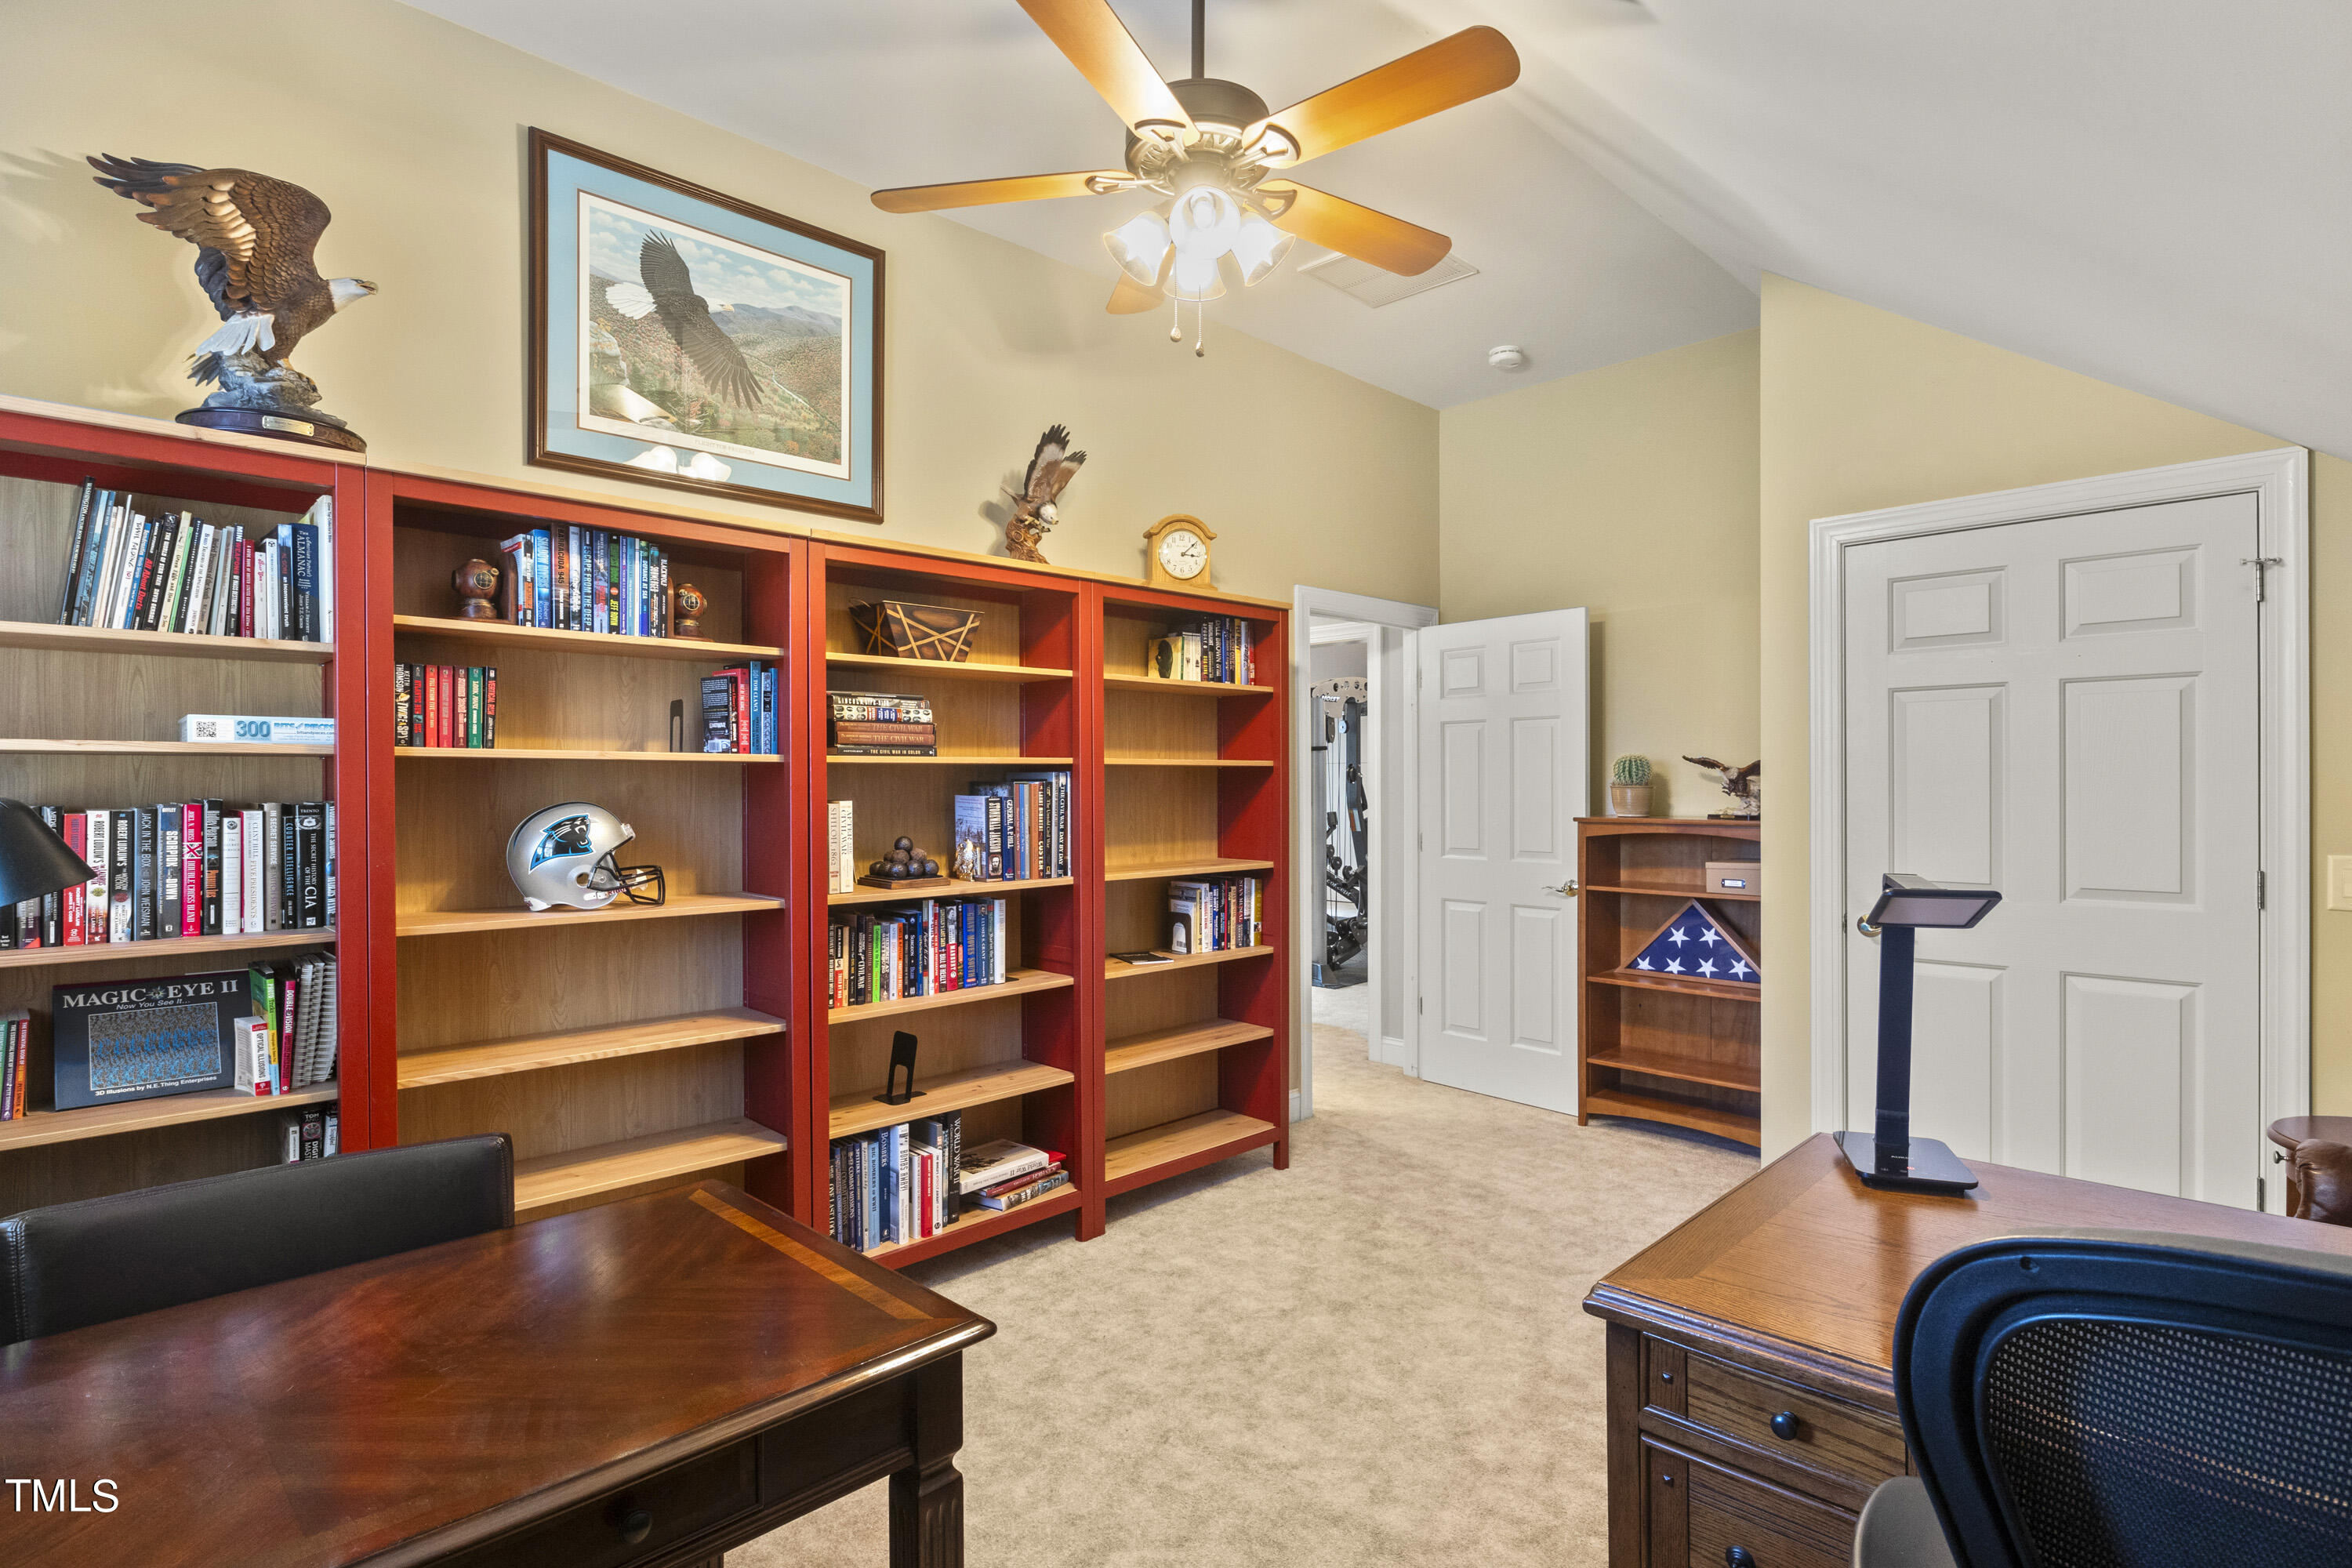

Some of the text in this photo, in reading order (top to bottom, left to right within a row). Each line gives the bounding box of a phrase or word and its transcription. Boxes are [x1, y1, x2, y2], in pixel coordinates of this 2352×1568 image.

[235, 525, 244, 543] MINI
[162, 541, 170, 556] WORLD
[232, 542, 241, 575] WEAPONS
[297, 535, 307, 577] ALMANAC
[583, 546, 592, 573] ESCAPE
[158, 563, 166, 574] STAR
[537, 536, 550, 589] SHADOW DIVERS
[140, 570, 151, 590] About
[231, 579, 240, 590] MASS
[583, 574, 592, 593] FROM
[136, 590, 147, 610] Darts
[151, 588, 160, 603] DAVID
[230, 590, 239, 615] DESTRUCTION
[583, 594, 592, 608] THE
[583, 609, 593, 626] DEEP
[396, 664, 405, 692] THOMSON
[488, 681, 496, 703] VERTICAL
[236, 720, 271, 738] 300
[397, 702, 409, 739] TWICE SPY
[141, 813, 151, 829] JACK
[206, 811, 220, 847] Ridley Pearson
[989, 802, 1002, 853] STONEWALL JACKSON
[93, 820, 105, 863] ROBERT LUDLUM'S
[116, 820, 129, 866] ROBERT LUDLUM'S
[141, 839, 151, 851] THE
[141, 854, 151, 867] BOX
[165, 830, 179, 900] SCORPION DOWN
[285, 823, 295, 896] COUNTER INTELLIGENCE
[140, 879, 151, 895] JOHN
[304, 887, 318, 909] CIA
[140, 897, 151, 927] WEISMAN
[967, 913, 975, 978] GRANT MOVES SOUTH
[62, 979, 239, 1009] MAGIC EYE II
[285, 990, 294, 1033] DOUBLE VISION
[256, 1033, 267, 1078] OPTICAL ILLUSIONS
[107, 1087, 135, 1095] Illusions
[180, 1076, 217, 1086] Enterprises
[900, 1150, 909, 1192] BOMBS AWAY!
